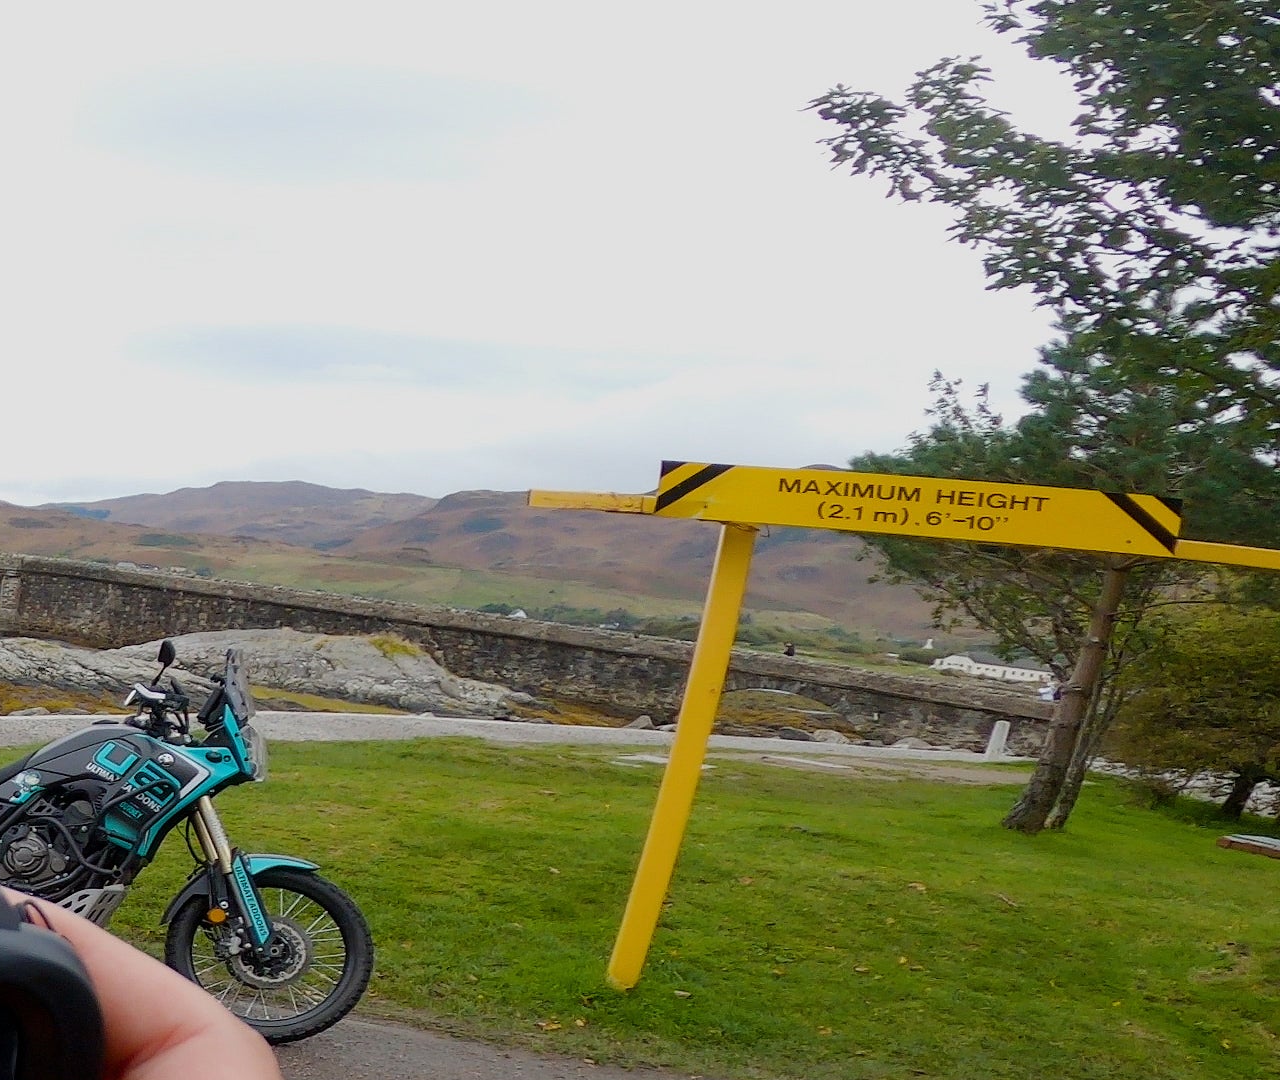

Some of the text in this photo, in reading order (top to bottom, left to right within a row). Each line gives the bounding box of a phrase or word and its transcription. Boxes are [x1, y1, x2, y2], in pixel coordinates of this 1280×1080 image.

[778, 477, 1051, 512] MAXIMUM HEIGHT
[817, 501, 864, 521] (2.1
